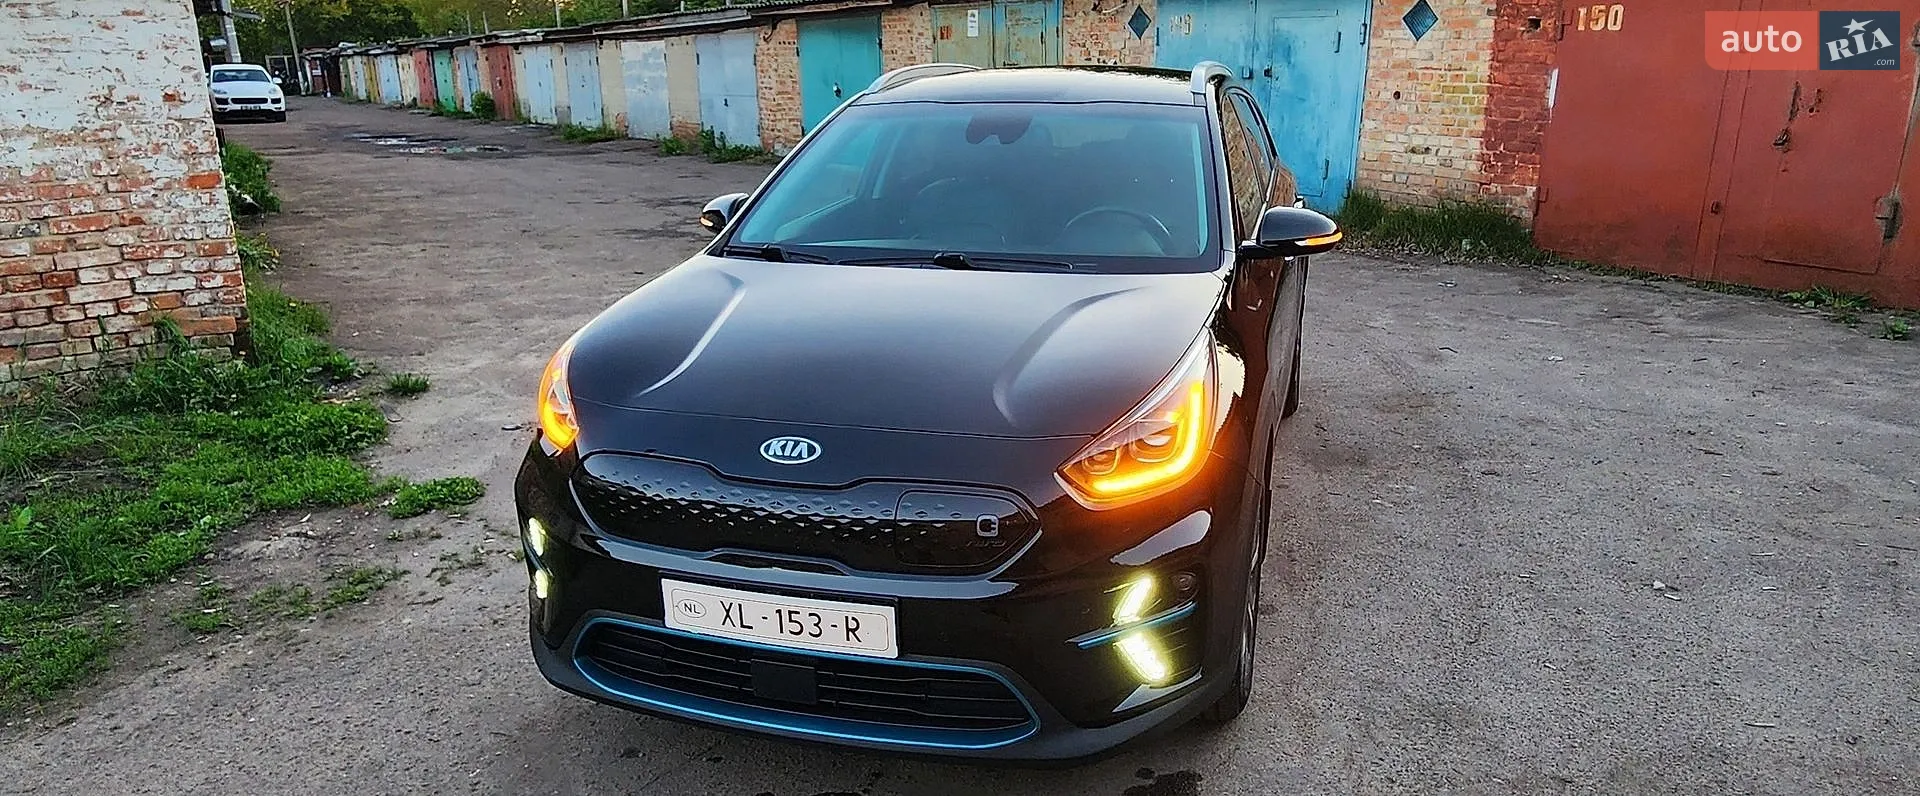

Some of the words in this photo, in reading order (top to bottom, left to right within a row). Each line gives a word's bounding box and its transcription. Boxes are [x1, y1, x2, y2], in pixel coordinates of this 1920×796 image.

[1577, 4, 1625, 31] 150
[768, 440, 808, 458] KIA
[684, 603, 701, 615] NL
